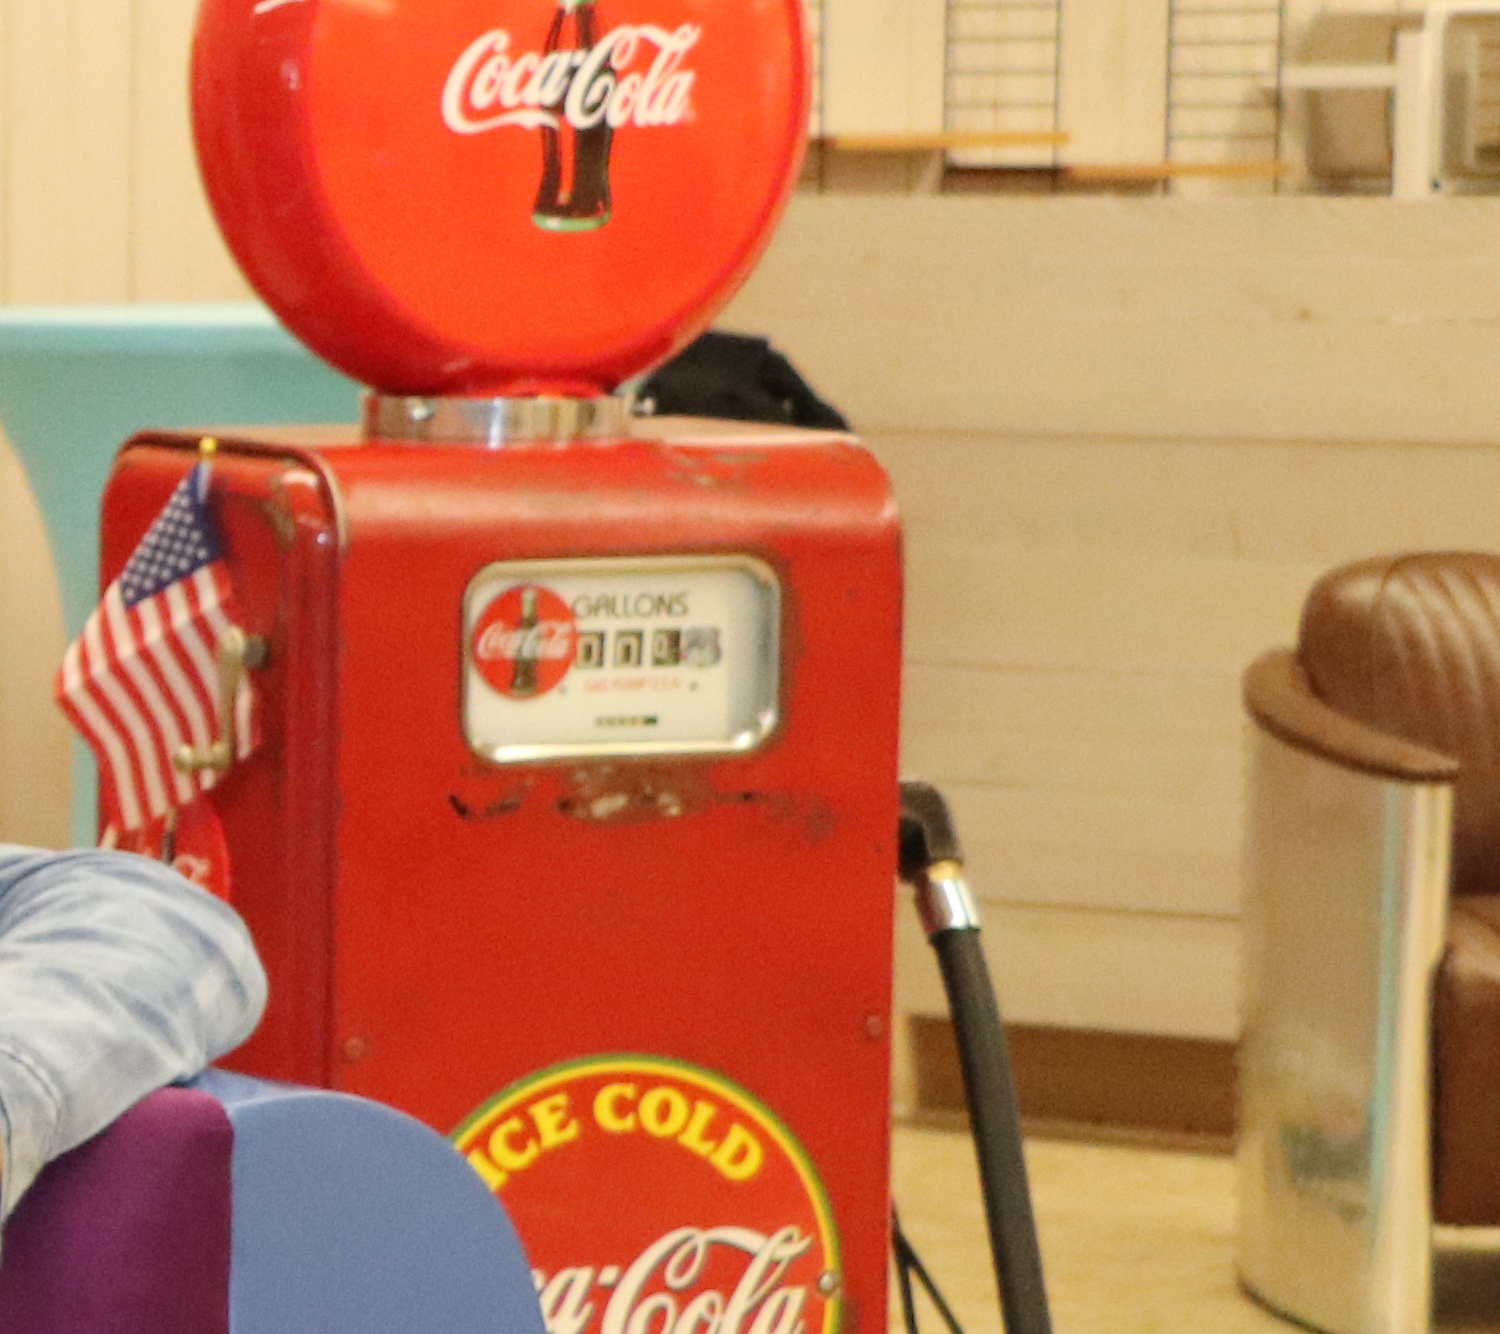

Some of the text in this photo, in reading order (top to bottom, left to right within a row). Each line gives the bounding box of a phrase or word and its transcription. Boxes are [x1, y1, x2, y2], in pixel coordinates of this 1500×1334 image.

[441, 23, 702, 135] Coca-Cola
[573, 591, 689, 618] GALLONS
[592, 1083, 763, 1181] COLD
